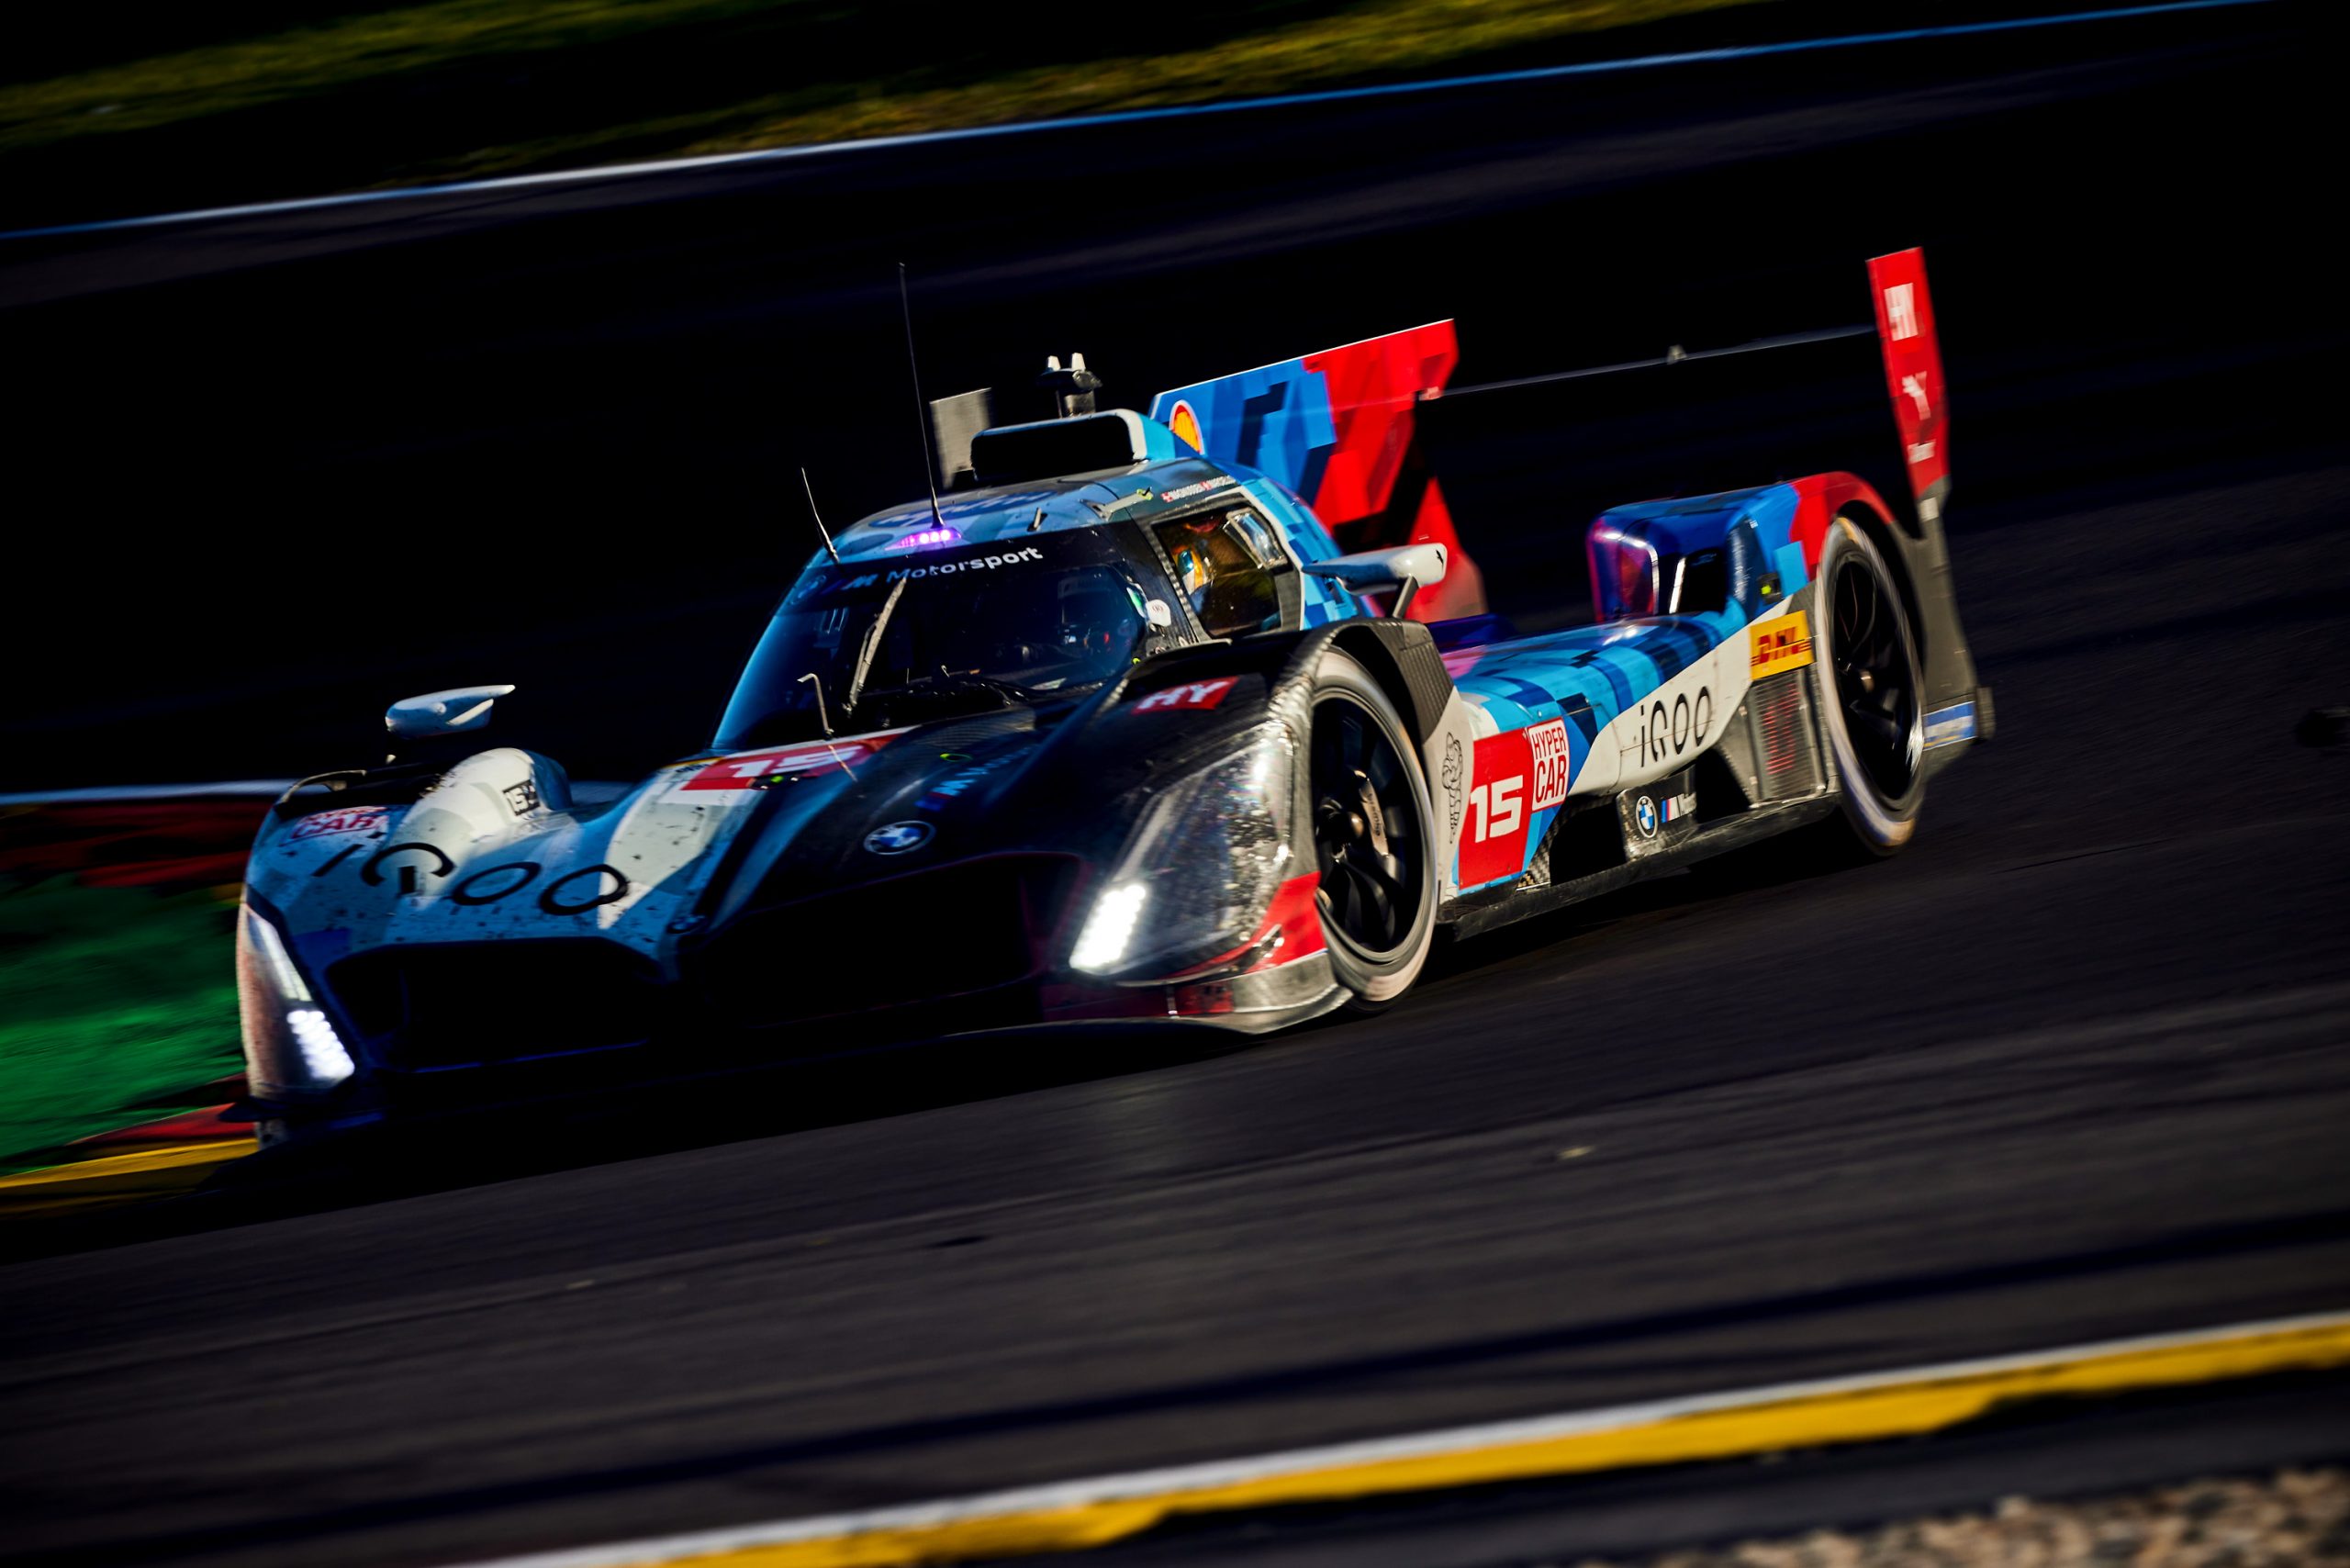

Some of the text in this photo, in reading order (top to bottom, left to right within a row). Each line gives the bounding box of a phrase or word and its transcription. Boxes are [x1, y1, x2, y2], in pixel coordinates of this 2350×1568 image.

[886, 547, 1044, 584] Motorsport
[1136, 681, 1230, 710] HY
[1532, 727, 1566, 759] HYPER
[728, 745, 865, 778] 15
[1536, 755, 1566, 803] CAR
[1470, 775, 1523, 843] 15
